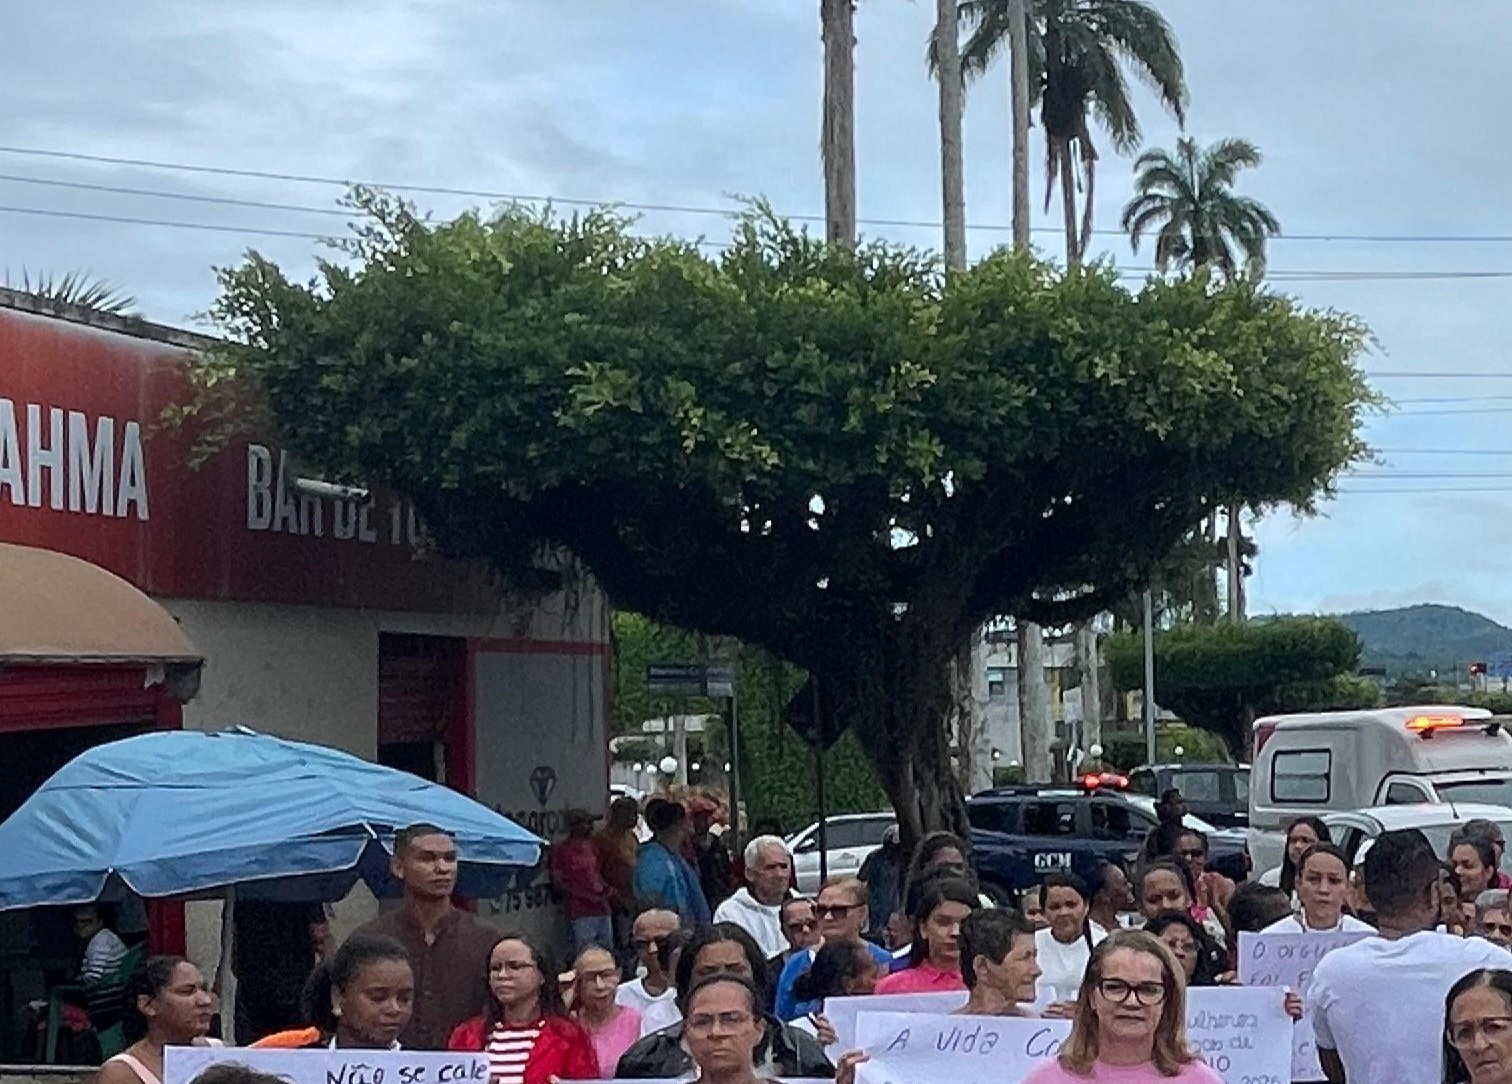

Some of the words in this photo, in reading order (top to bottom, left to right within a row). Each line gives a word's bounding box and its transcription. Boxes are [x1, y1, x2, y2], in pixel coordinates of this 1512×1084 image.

[1035, 852, 1071, 868] GCM
[887, 1028, 911, 1052] A
[438, 1058, 488, 1084] cale
